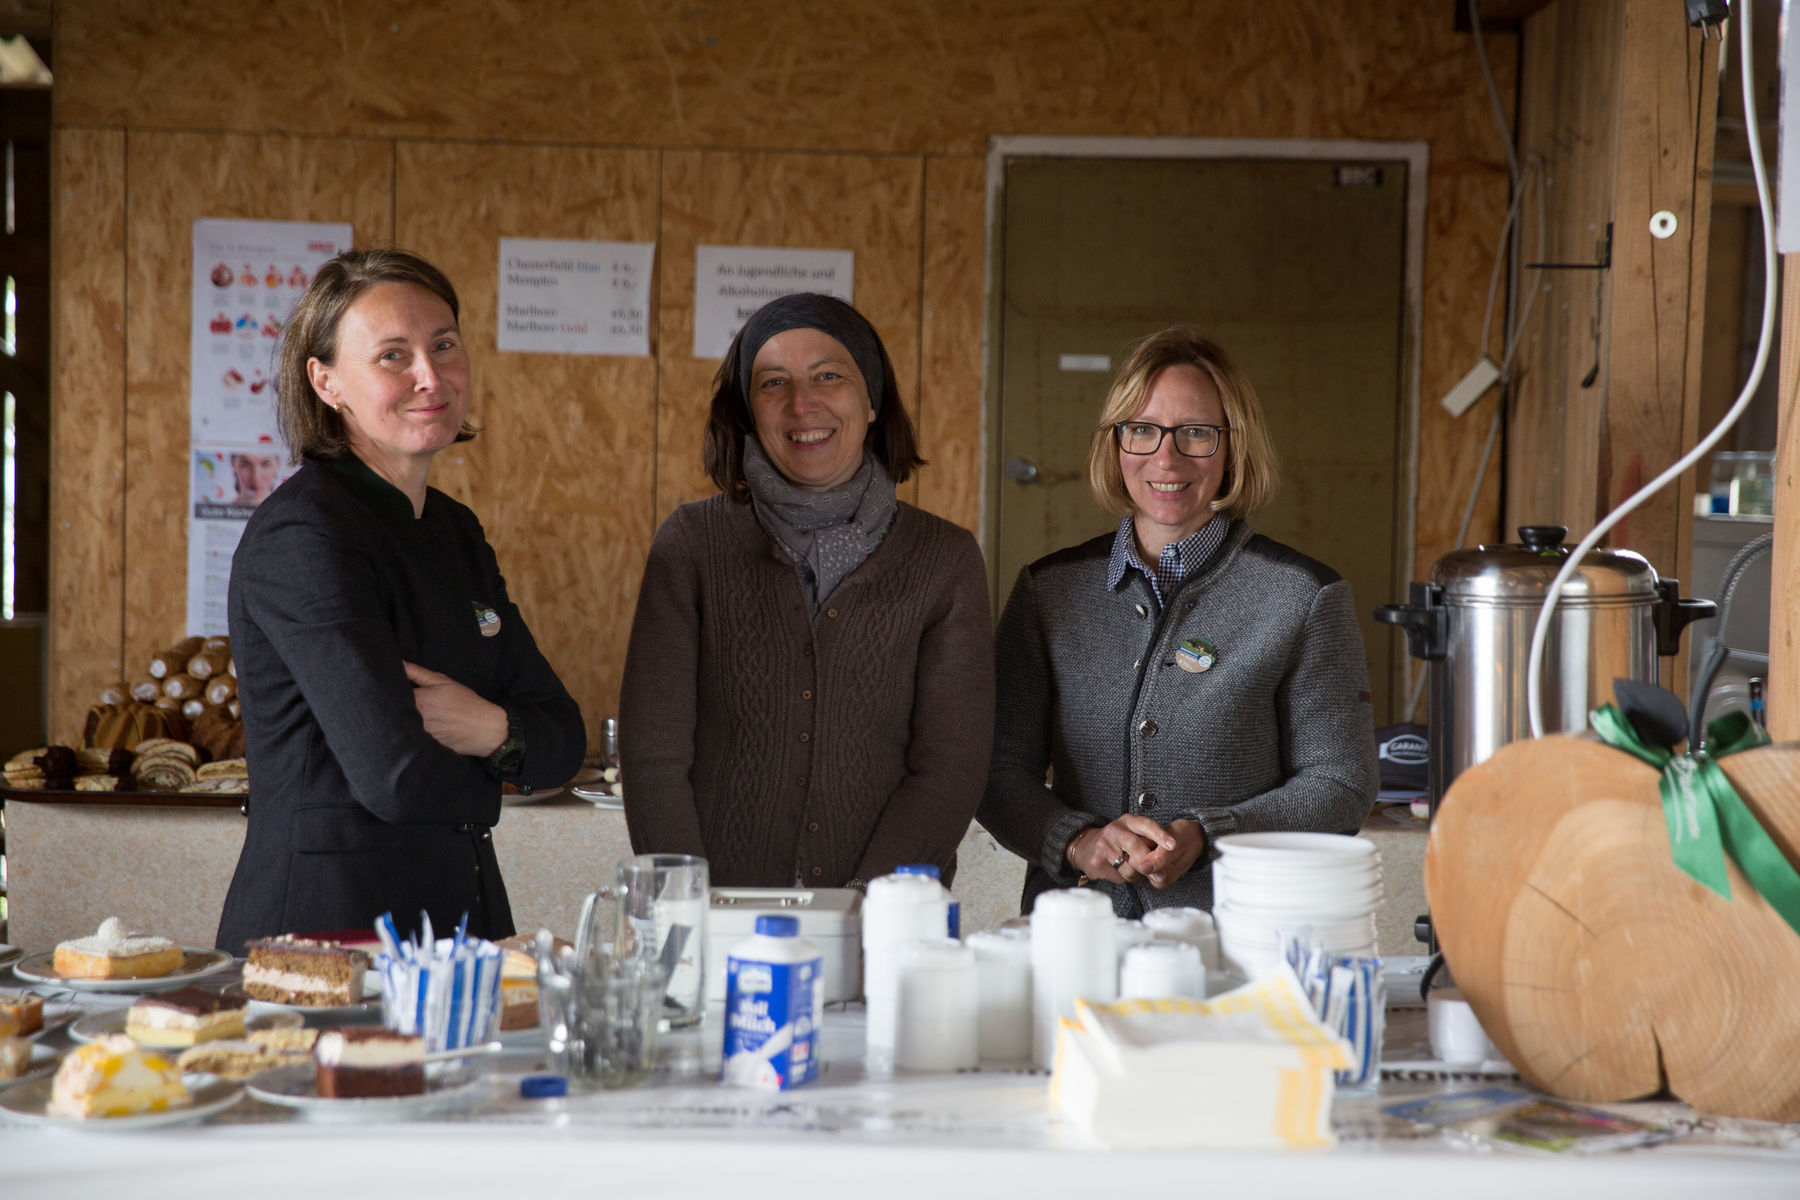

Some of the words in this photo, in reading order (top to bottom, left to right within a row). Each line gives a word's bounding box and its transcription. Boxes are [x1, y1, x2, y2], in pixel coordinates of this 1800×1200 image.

[738, 264, 808, 280] Jugendliche
[812, 268, 836, 281] und
[506, 303, 558, 317] Marlboro
[506, 320, 556, 334] Marlboro
[559, 321, 588, 335] Gold
